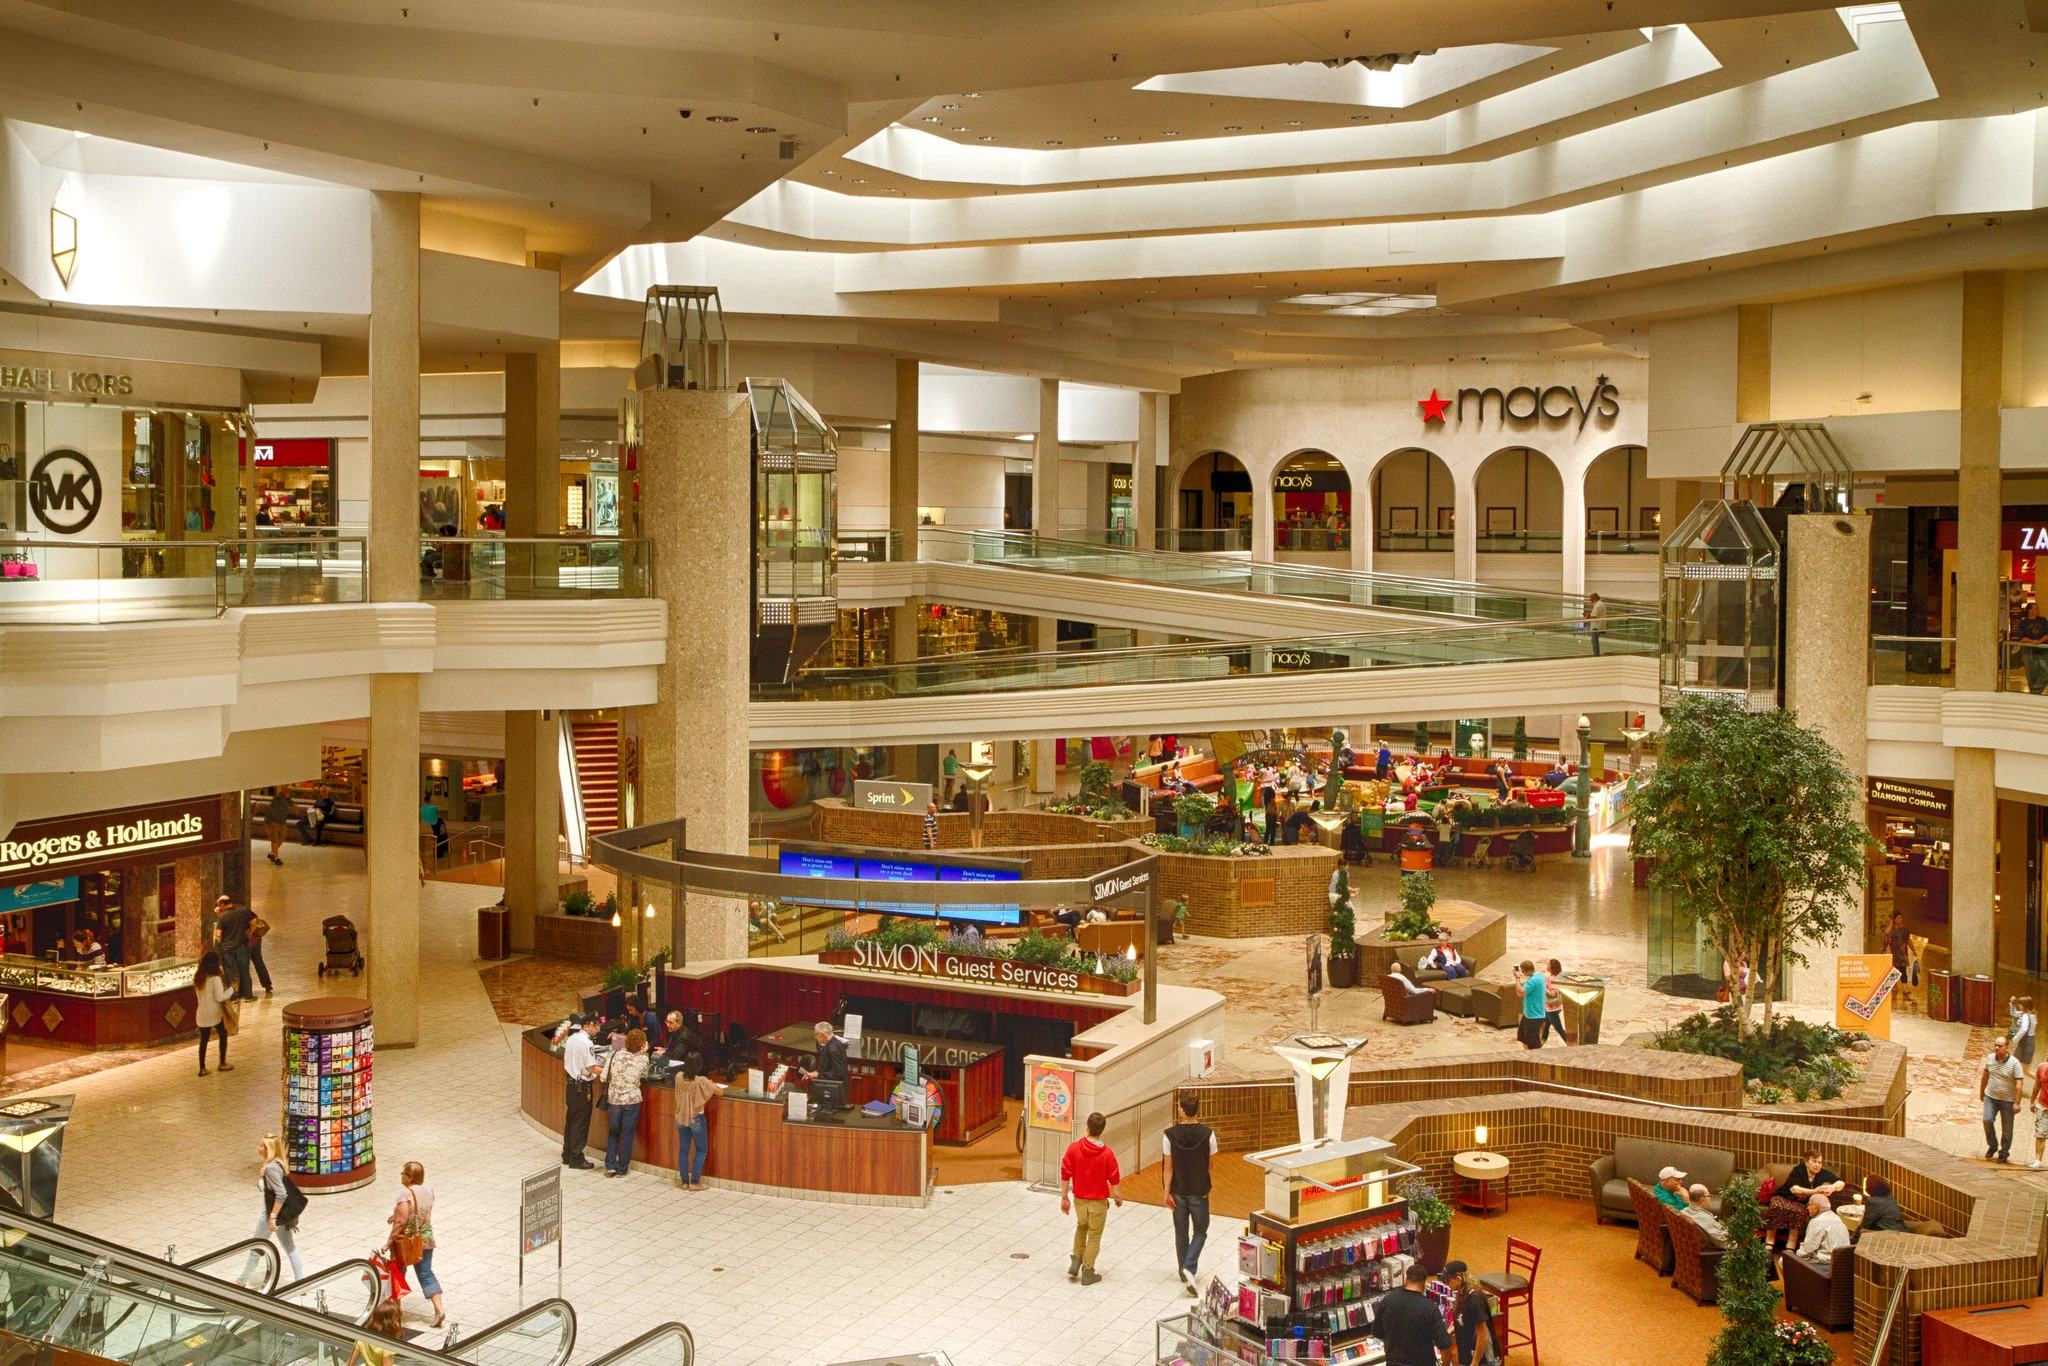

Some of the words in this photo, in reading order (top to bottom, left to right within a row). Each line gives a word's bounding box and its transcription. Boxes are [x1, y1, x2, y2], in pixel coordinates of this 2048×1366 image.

[68, 370, 133, 395] KORS
[1458, 373, 1620, 431] macy's
[38, 473, 92, 510] MK
[1113, 479, 1126, 488] GOLD
[867, 792, 895, 804] Sprint
[1871, 790, 1907, 803] DIAMOND
[1909, 797, 1947, 810] COMPANY
[1883, 783, 1935, 798] INTERNATIONAL
[0, 833, 81, 866] Rogers
[85, 830, 102, 848] &
[107, 813, 203, 846] Hollands
[1095, 877, 1119, 900] SIMON
[1120, 877, 1132, 891] Guest
[1132, 872, 1150, 886] Services
[853, 939, 939, 974] SIMON
[946, 957, 995, 980] Guest
[1001, 962, 1079, 989] Services
[526, 1176, 557, 1192] ticketmaster
[525, 1204, 536, 1215] BUY
[537, 1195, 558, 1213] TICKETS
[525, 1213, 537, 1224] HERE
[537, 1210, 544, 1219] AT
[544, 1203, 558, 1216] SIMON
[525, 1221, 539, 1233] GUEST
[540, 1213, 558, 1226] SERVICES
